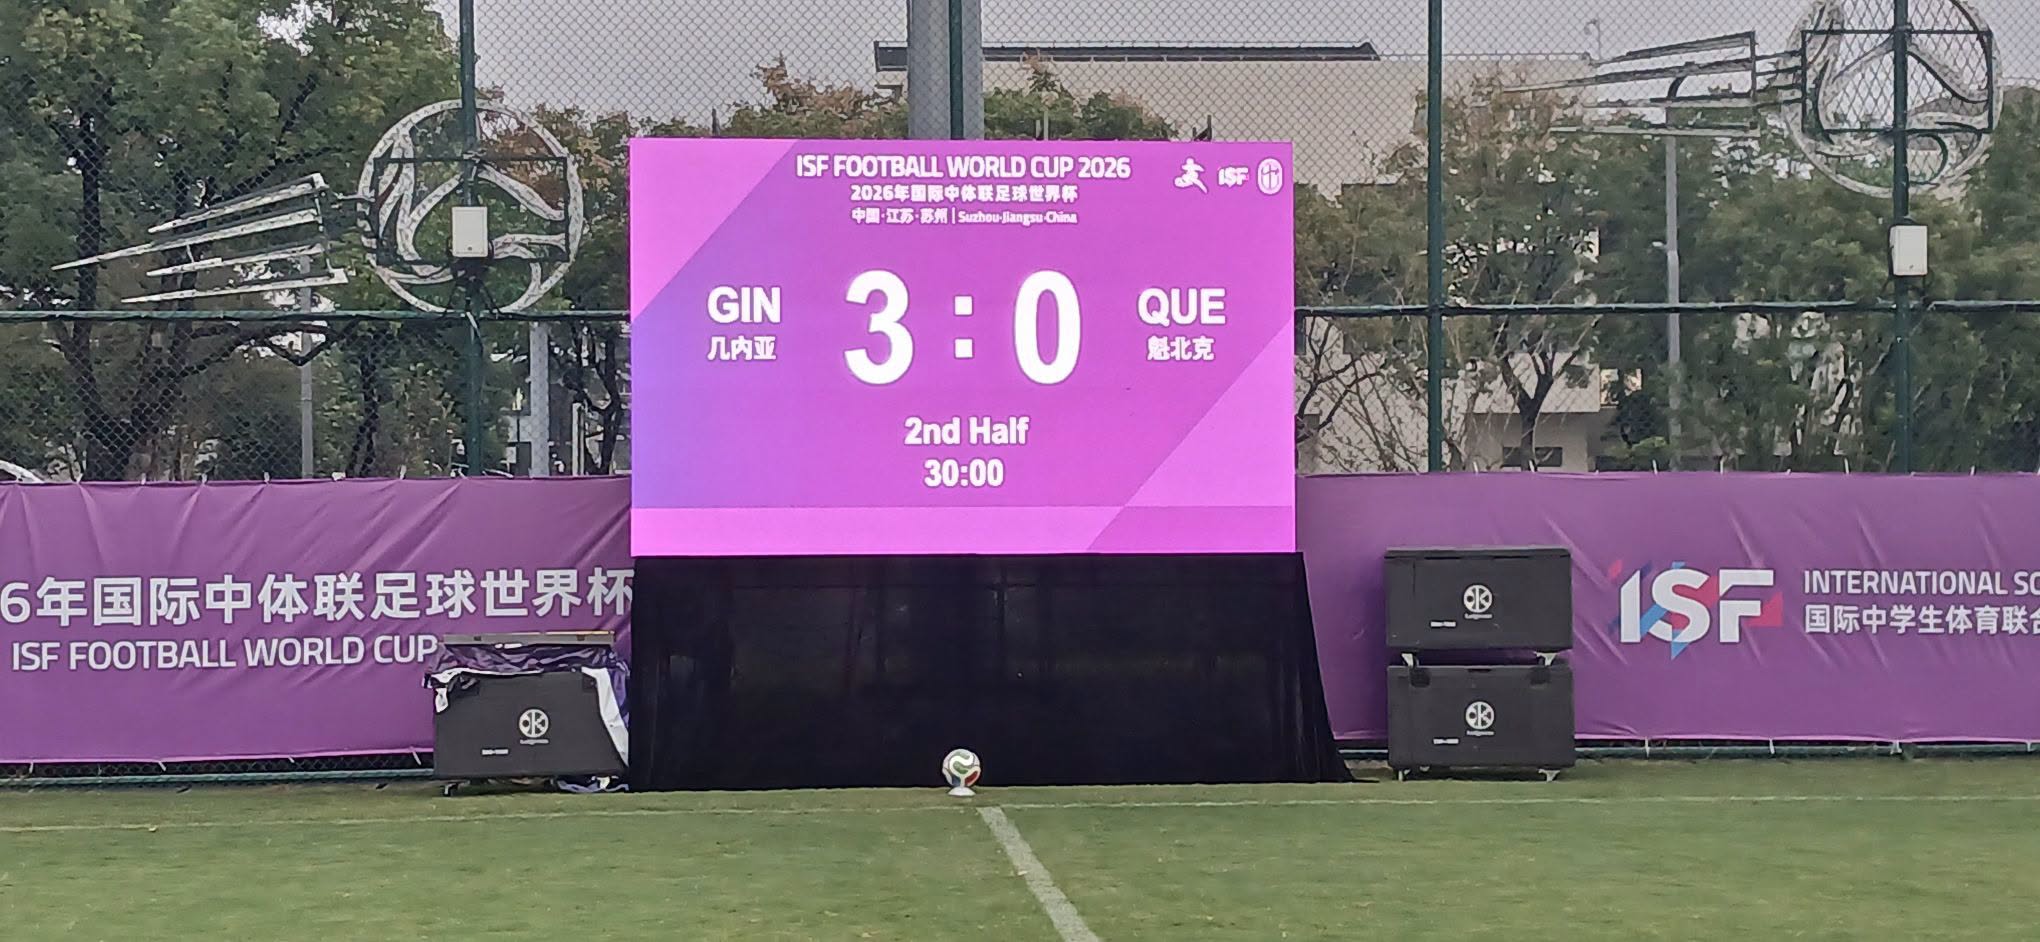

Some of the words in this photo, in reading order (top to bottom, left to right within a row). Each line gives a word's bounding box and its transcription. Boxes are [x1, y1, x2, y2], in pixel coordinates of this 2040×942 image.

[797, 154, 829, 178] ISF
[834, 155, 944, 178] FOOTBALL
[946, 156, 1027, 178] WORLD
[1030, 156, 1074, 178] CUP
[1078, 157, 1132, 179] 2026
[1218, 166, 1249, 187] ISF
[851, 184, 1078, 202] 2026年国际中体联足球世界杯
[707, 286, 782, 323] GIN
[1138, 288, 1227, 327] QUE
[845, 270, 913, 384] 3
[1014, 271, 1082, 384] 0
[707, 335, 777, 361] 几内亚
[1148, 335, 1215, 361] 魁北克
[905, 417, 960, 445] 2nd
[969, 416, 1029, 444] Half
[925, 459, 1004, 487] 30:00
[1804, 570, 2009, 595] INTERNATIONAL
[1620, 568, 1775, 643] ISF
[12, 641, 61, 671] ISF
[69, 639, 236, 670] FOOTBALL
[243, 636, 365, 667] WORLD
[374, 634, 438, 663] CUP
